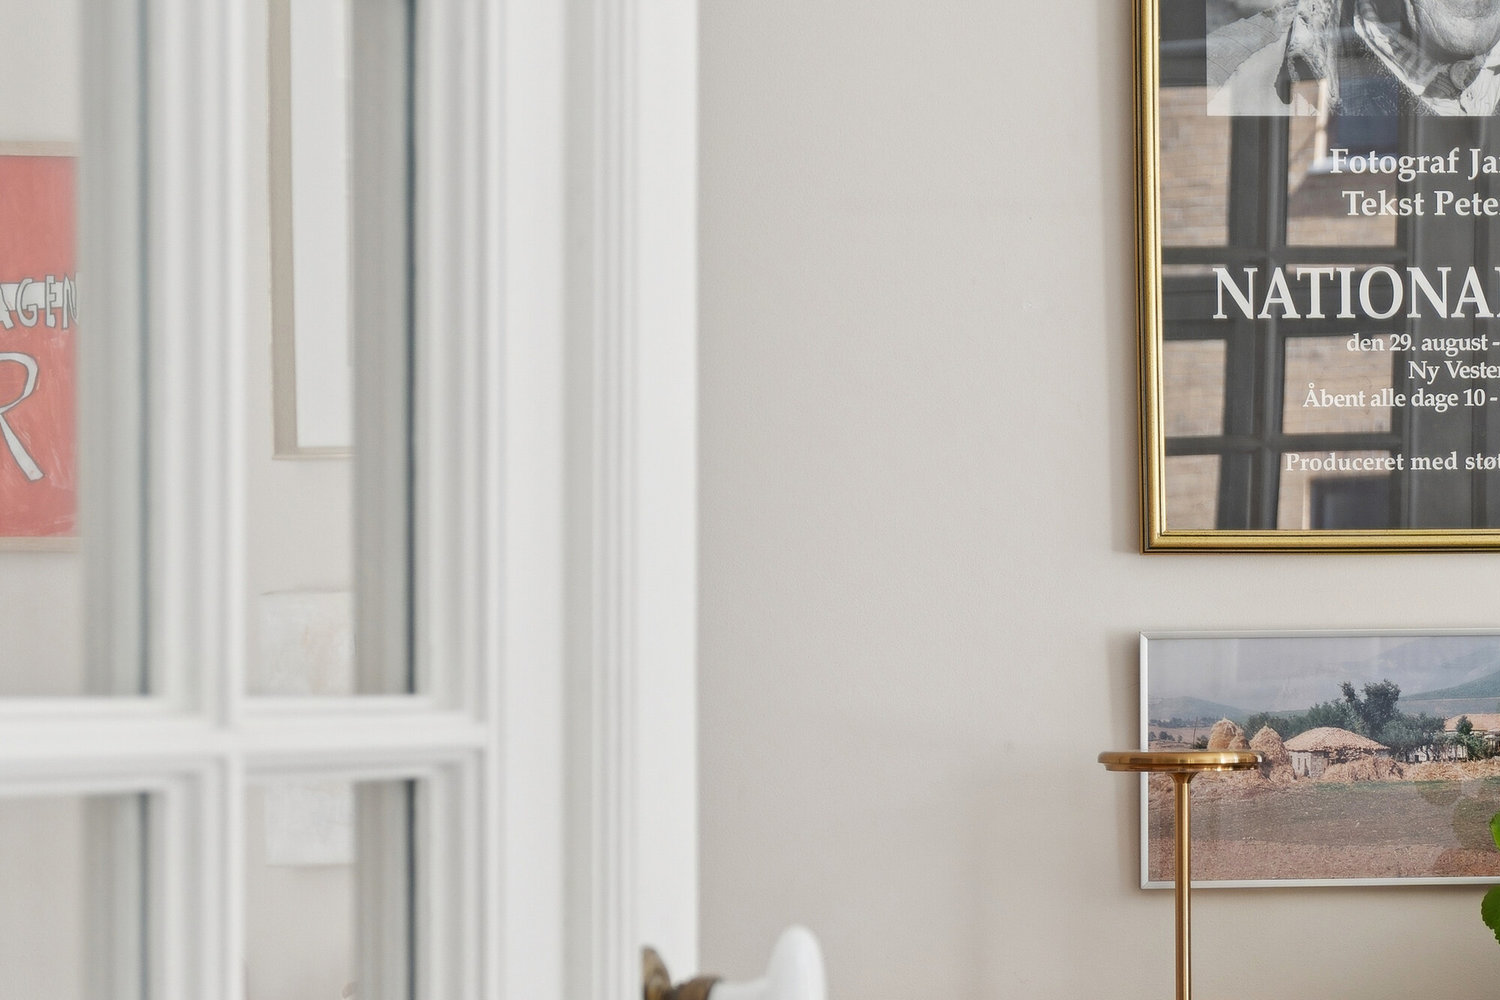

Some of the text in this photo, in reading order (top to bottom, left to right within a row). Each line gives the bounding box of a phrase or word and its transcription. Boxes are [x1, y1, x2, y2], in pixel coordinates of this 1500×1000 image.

[1329, 146, 1460, 183] Fotograf
[1341, 189, 1425, 217] Tekst
[1346, 332, 1385, 352] den
[1389, 333, 1417, 352] 29.
[1420, 333, 1489, 358] august
[1407, 360, 1441, 385] Ny
[1303, 382, 1366, 408] Åbent
[1370, 387, 1407, 408] alle
[1410, 387, 1459, 413] dage
[1462, 388, 1486, 407] 10
[1285, 452, 1405, 471] Produceret
[1410, 450, 1459, 471] med
